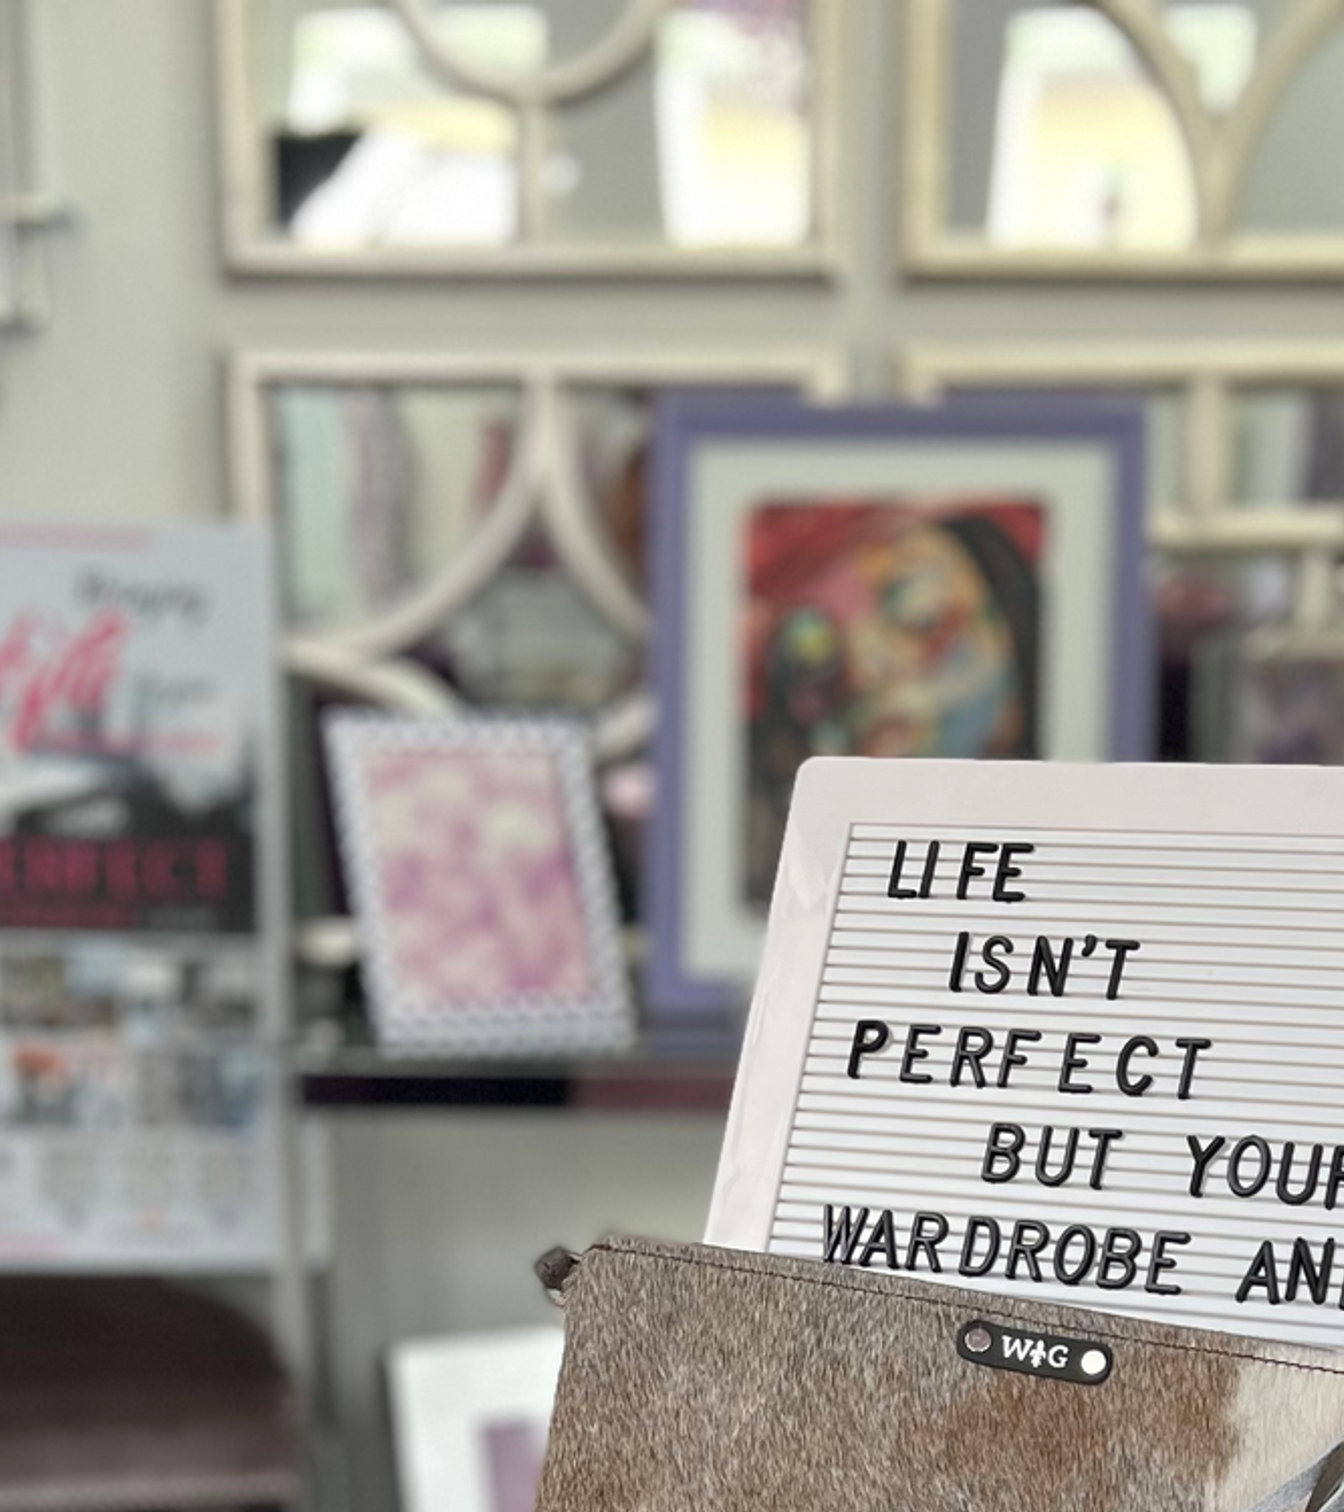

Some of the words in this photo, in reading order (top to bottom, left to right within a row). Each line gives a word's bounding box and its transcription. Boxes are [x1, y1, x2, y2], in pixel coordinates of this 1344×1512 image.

[886, 840, 1036, 905] LIFE
[948, 931, 1141, 1001] ISN'T
[846, 1020, 1212, 1100] PERFECT
[980, 1122, 1124, 1192] BUT
[822, 1203, 1192, 1297] WARDROBE
